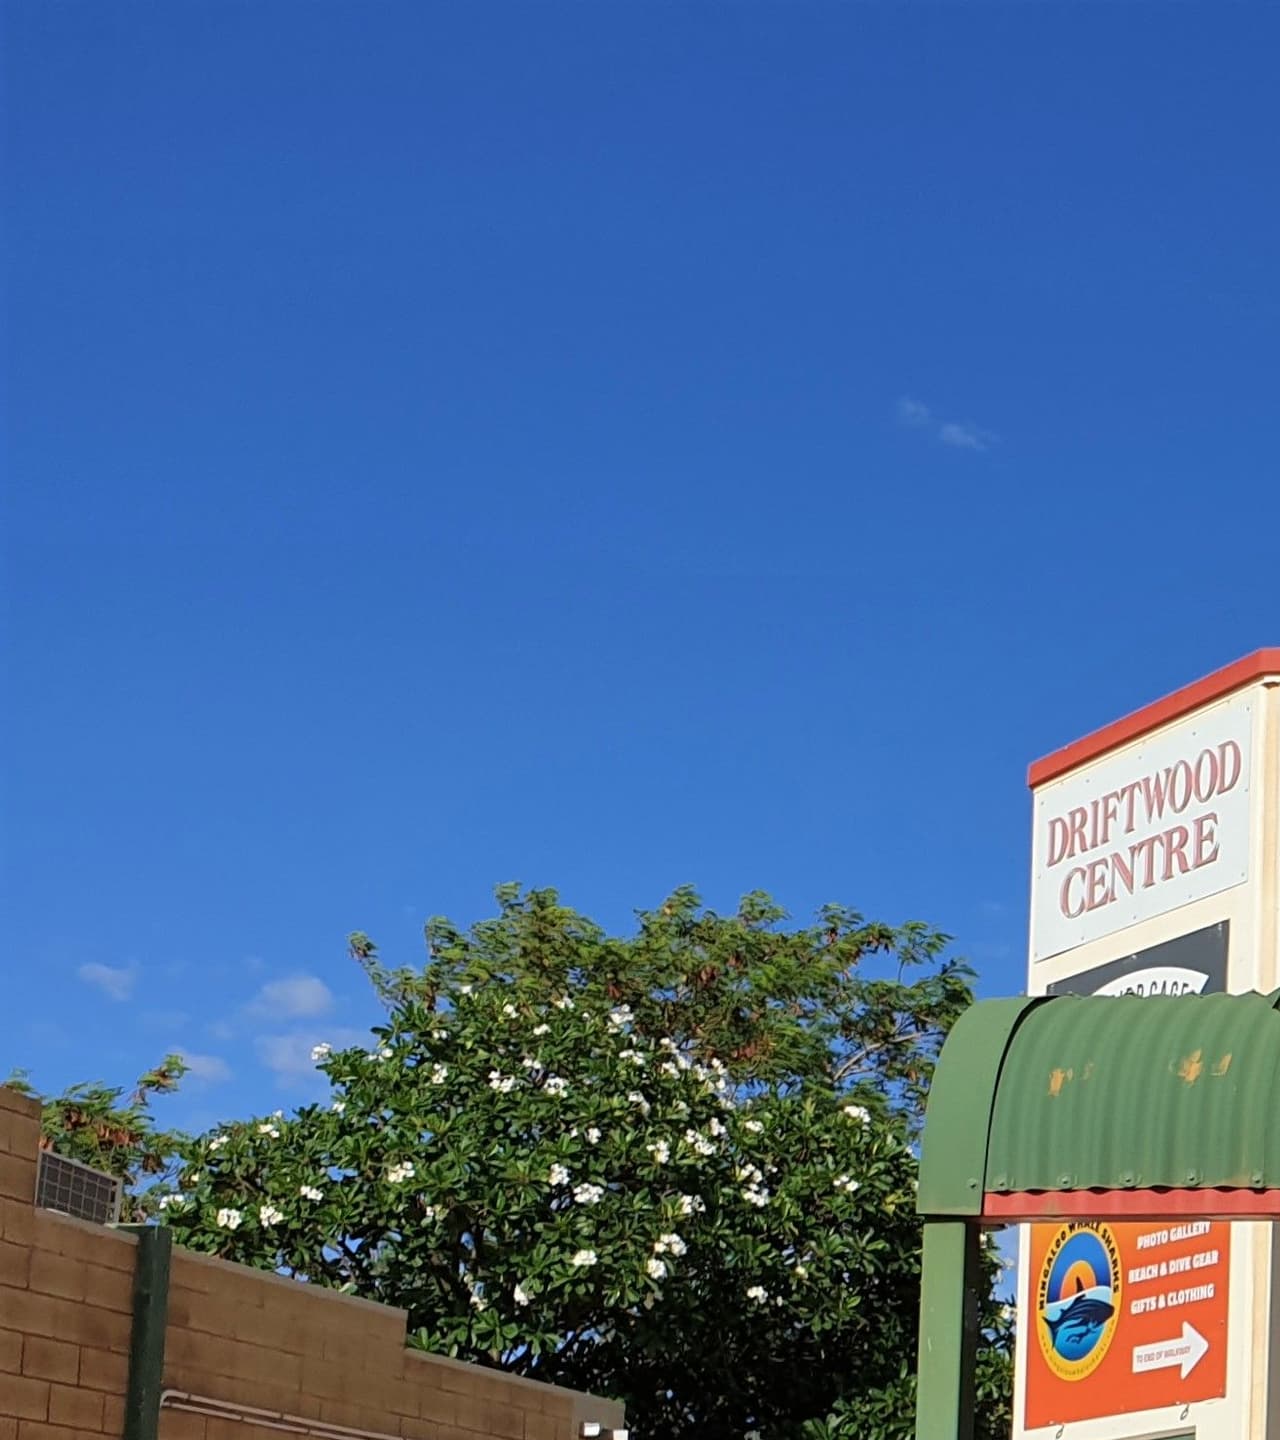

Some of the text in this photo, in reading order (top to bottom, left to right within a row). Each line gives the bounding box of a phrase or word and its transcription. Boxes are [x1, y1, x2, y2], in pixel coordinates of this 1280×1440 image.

[1046, 740, 1242, 868] DRIFTWOOD
[1059, 812, 1220, 919] CENTRE
[1136, 1221, 1211, 1251] PHOTO GALLERY
[1127, 1249, 1219, 1284] BEACH & DIVE GEAR
[1130, 1283, 1215, 1316] GIFTS & CLOTHING
